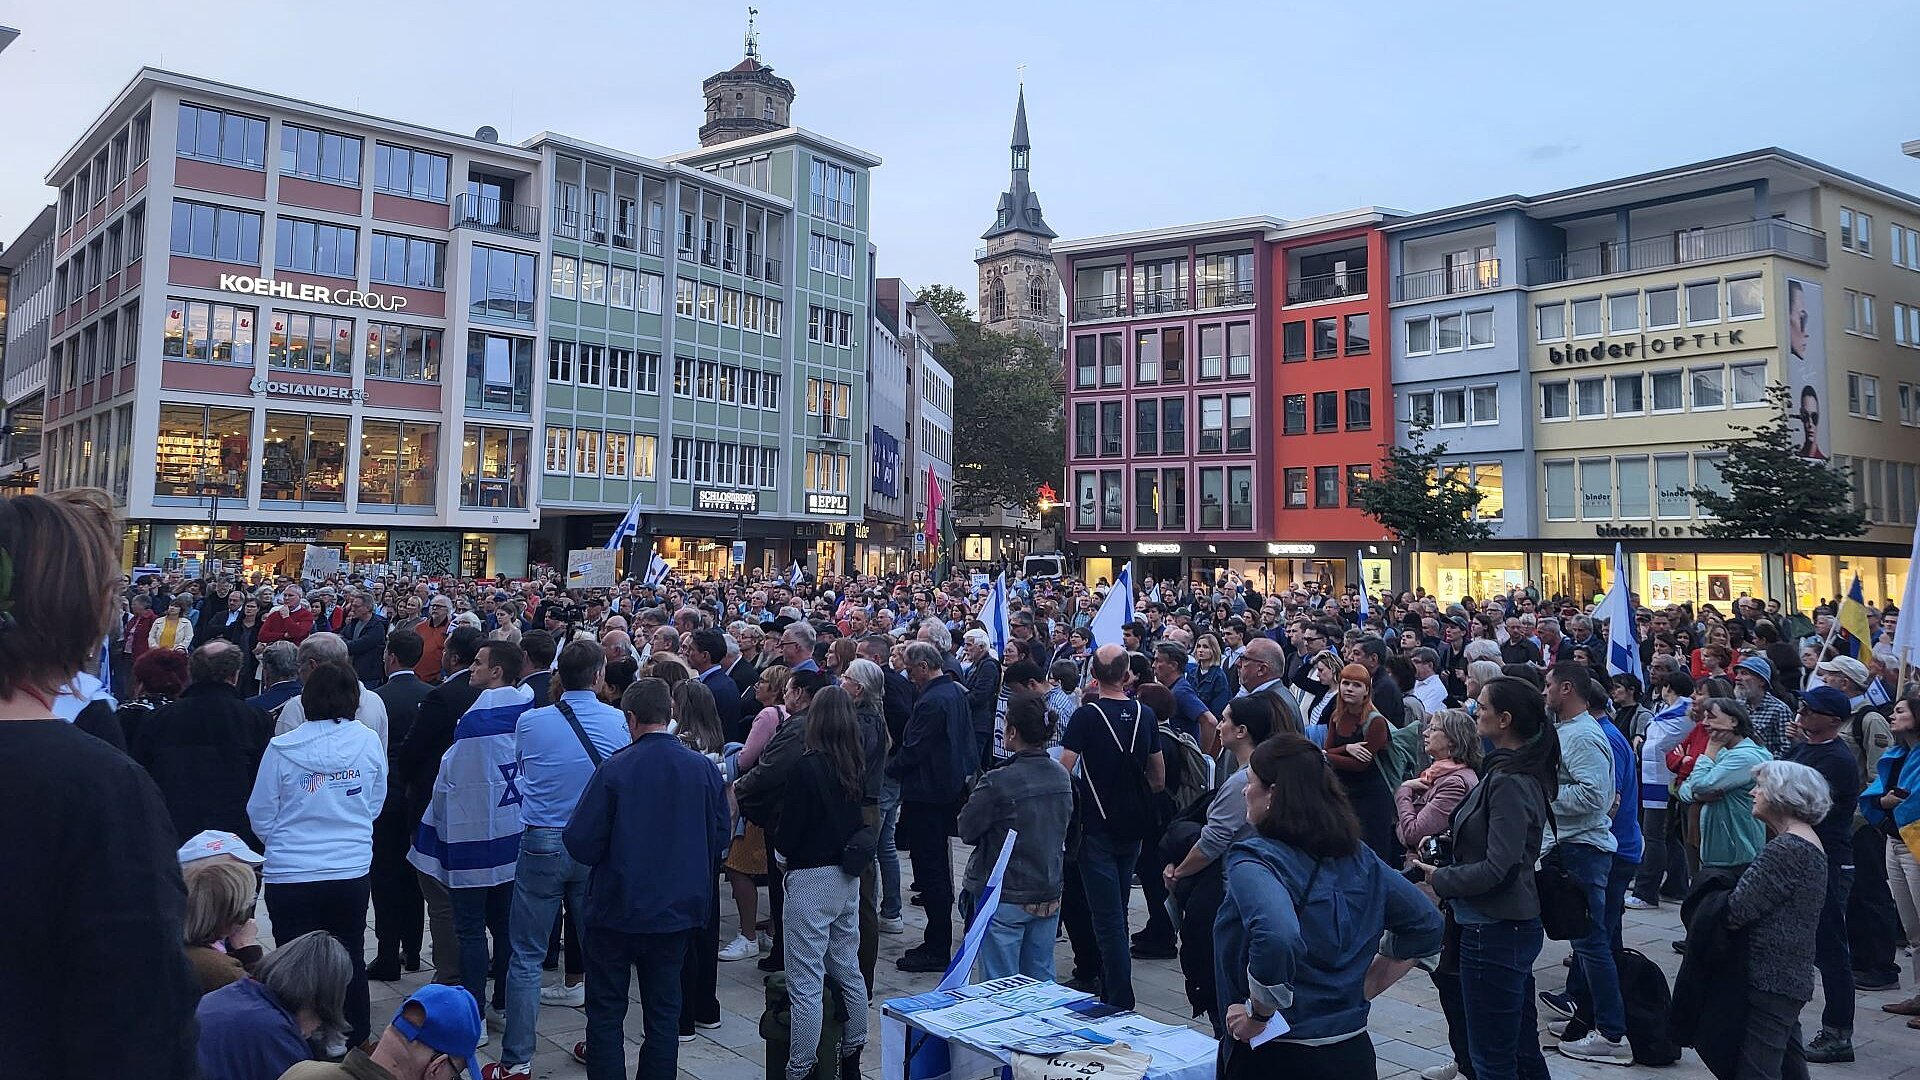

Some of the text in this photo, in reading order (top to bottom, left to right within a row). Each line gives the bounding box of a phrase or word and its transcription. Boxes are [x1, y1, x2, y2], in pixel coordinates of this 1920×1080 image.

[220, 273, 408, 312] KOEHLER.GROUP
[1549, 329, 1744, 365] binder OPTIK
[818, 495, 847, 509] EPPLI
[1596, 523, 1650, 538] binder
[329, 769, 361, 781] SCORA
